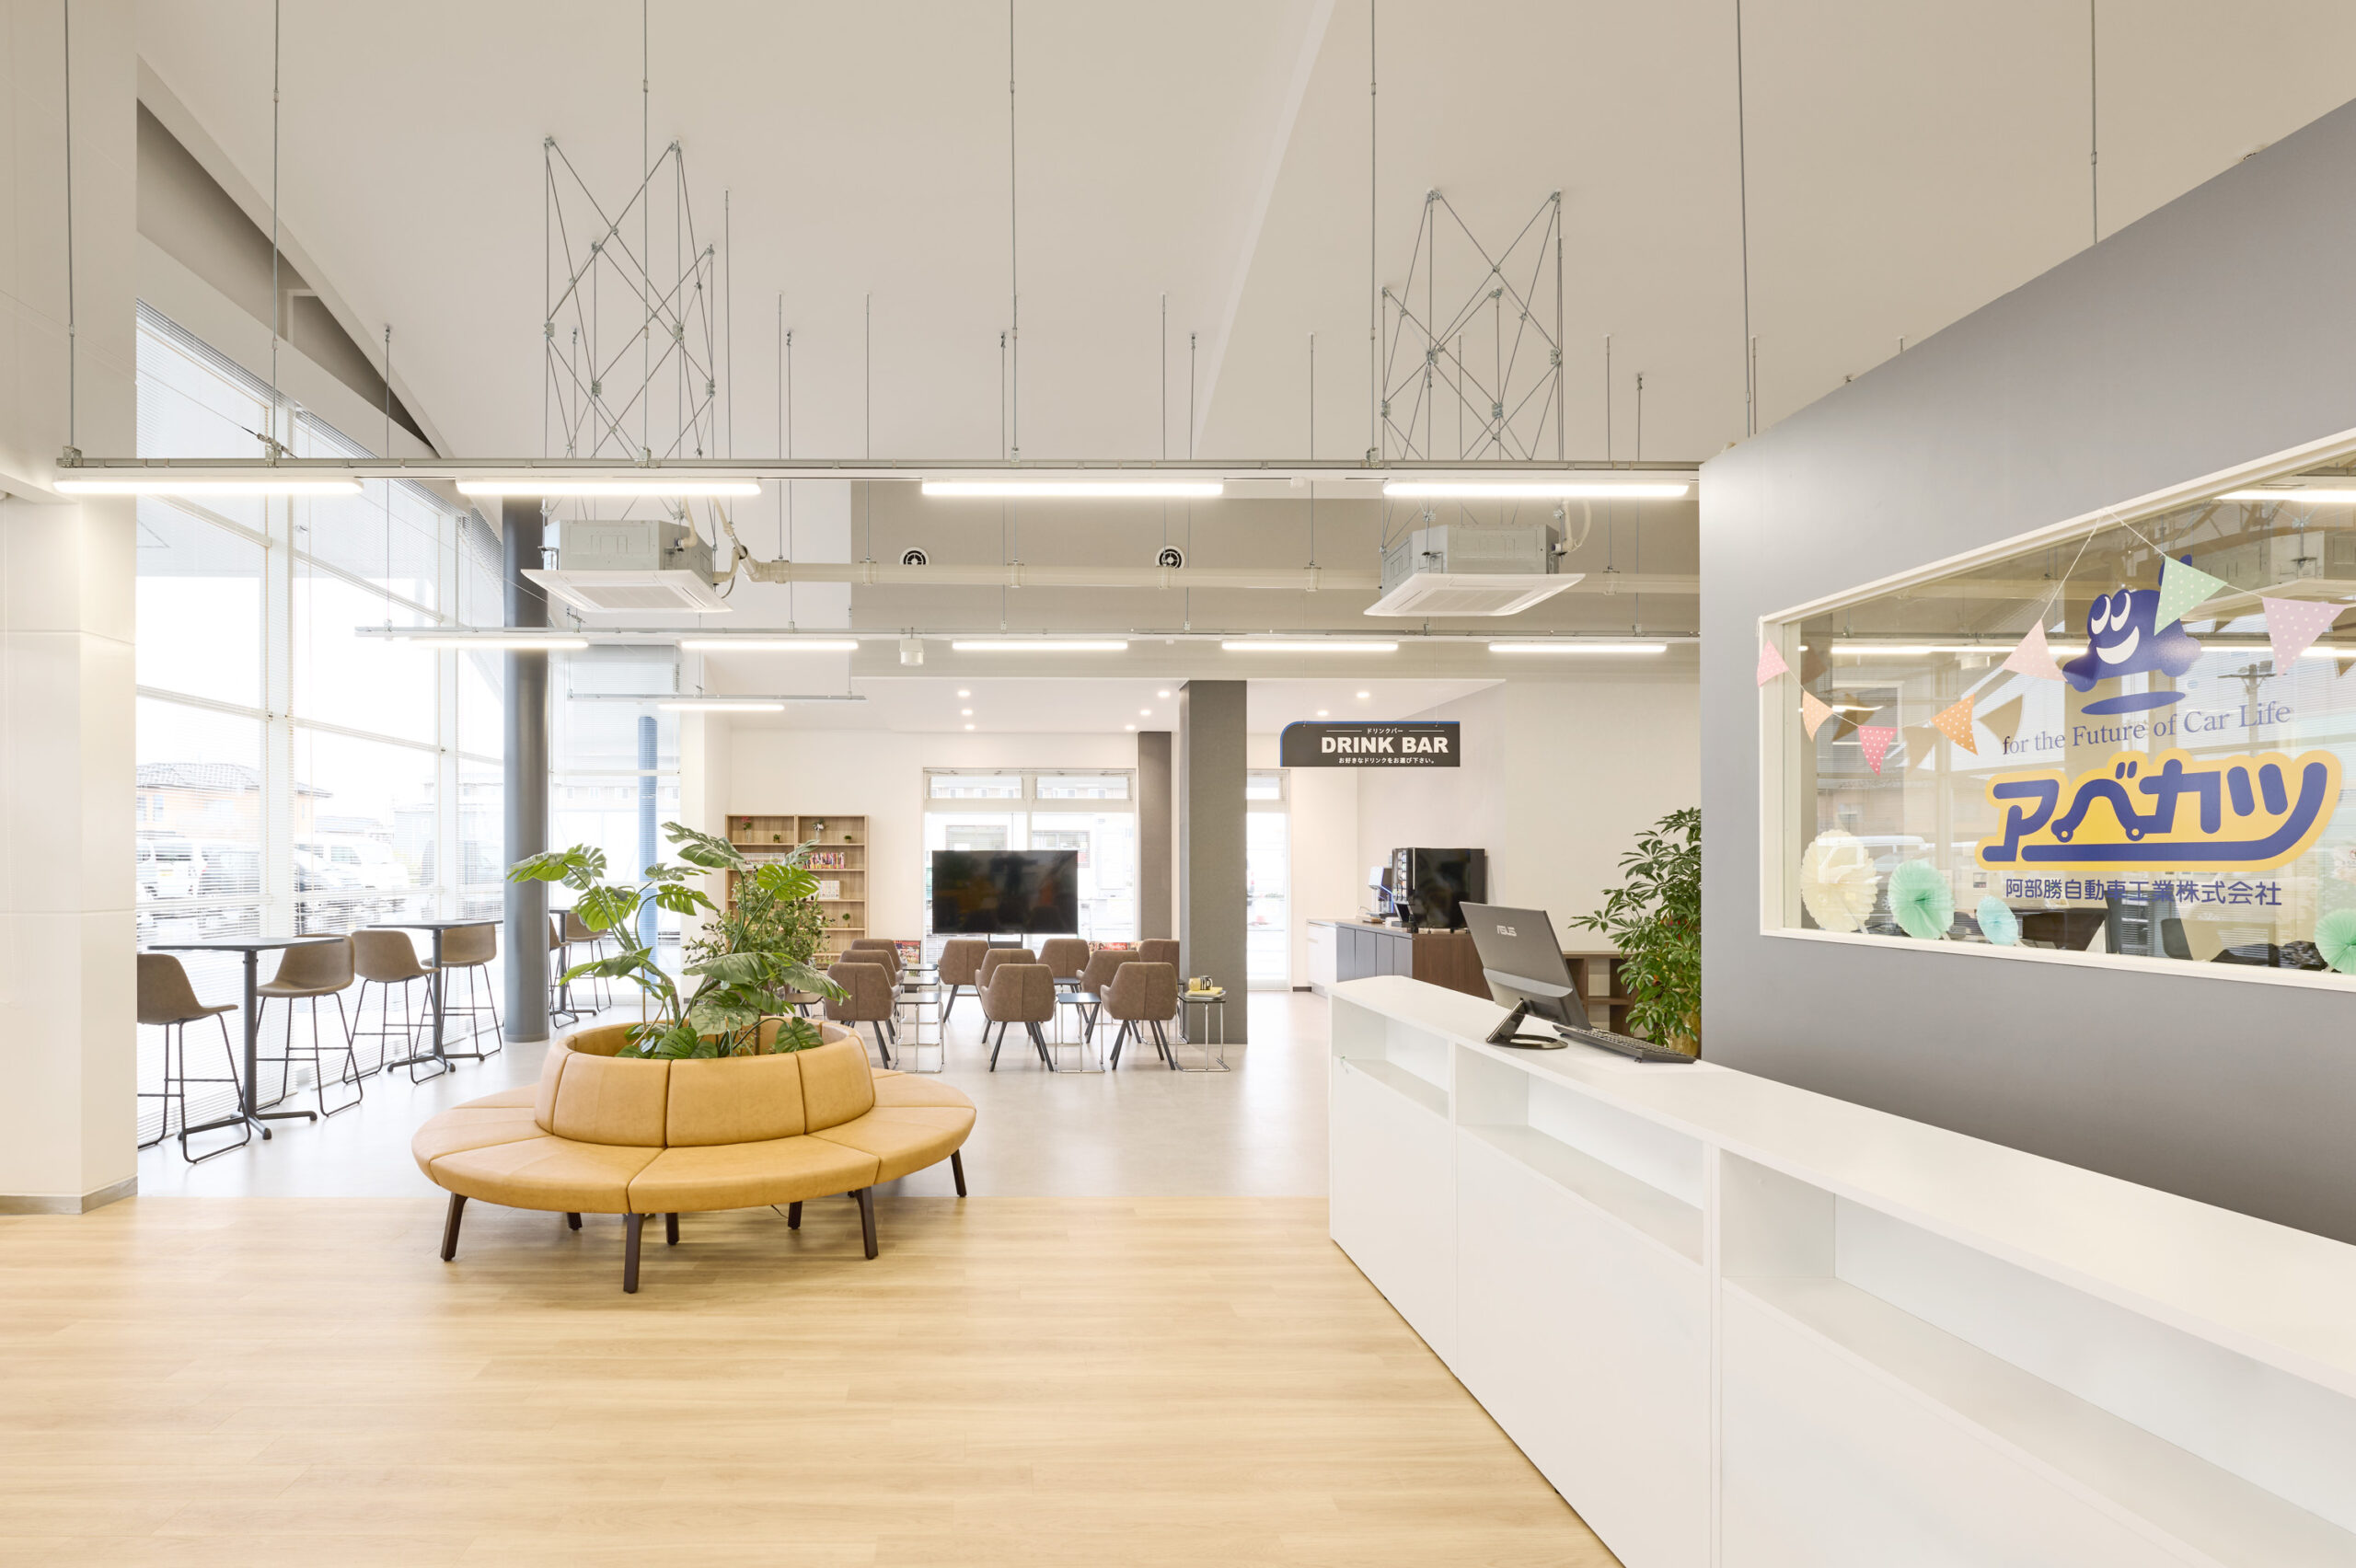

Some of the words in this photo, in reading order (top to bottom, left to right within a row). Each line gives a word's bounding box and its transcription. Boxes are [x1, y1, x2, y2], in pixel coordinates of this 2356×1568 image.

[1321, 736, 1394, 754] DRINK
[1402, 736, 1449, 754] BAR
[2002, 735, 2028, 755] for
[2034, 731, 2065, 750] the
[2072, 722, 2145, 747] Future
[2153, 714, 2178, 737] of
[2184, 710, 2230, 734] Car
[2239, 700, 2292, 728] Life
[1981, 758, 2327, 862] アベカツ
[2005, 878, 2282, 906] 阿部勝自動車工業株式会社
